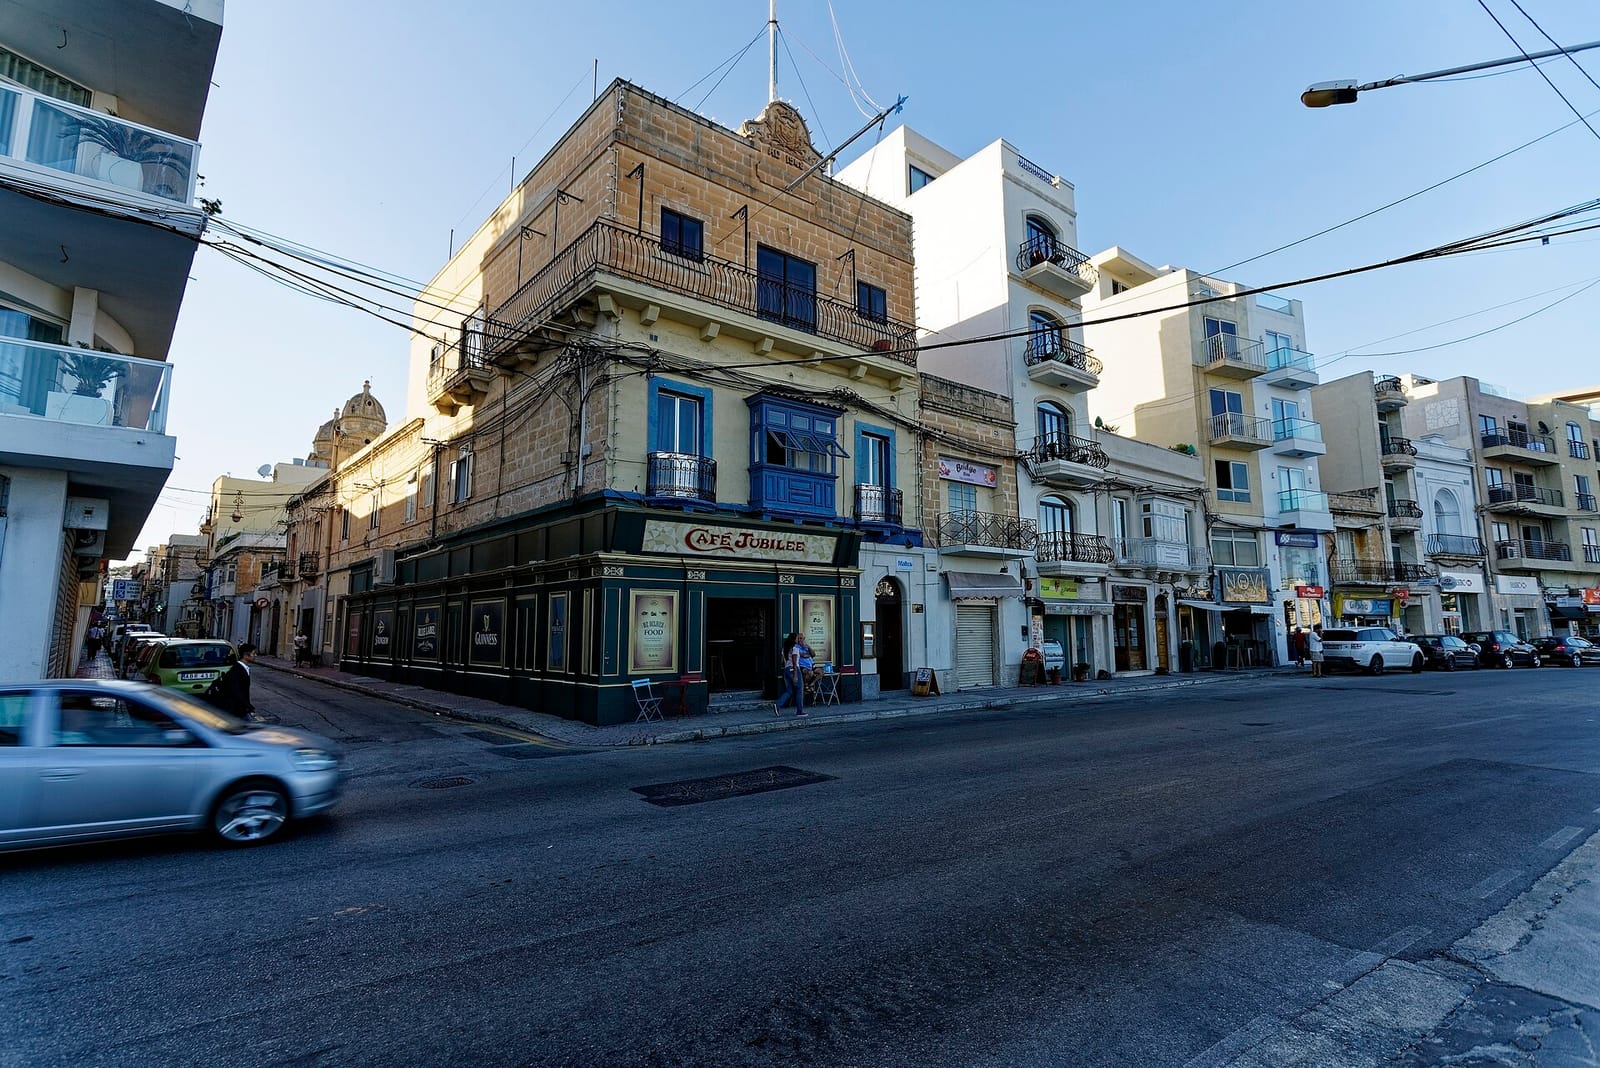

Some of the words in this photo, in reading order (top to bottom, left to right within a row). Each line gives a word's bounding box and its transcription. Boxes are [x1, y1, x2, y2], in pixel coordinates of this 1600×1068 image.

[735, 533, 805, 552] JUBILEE
[1225, 573, 1264, 590] NOVI
[474, 631, 498, 646] GUINNESS
